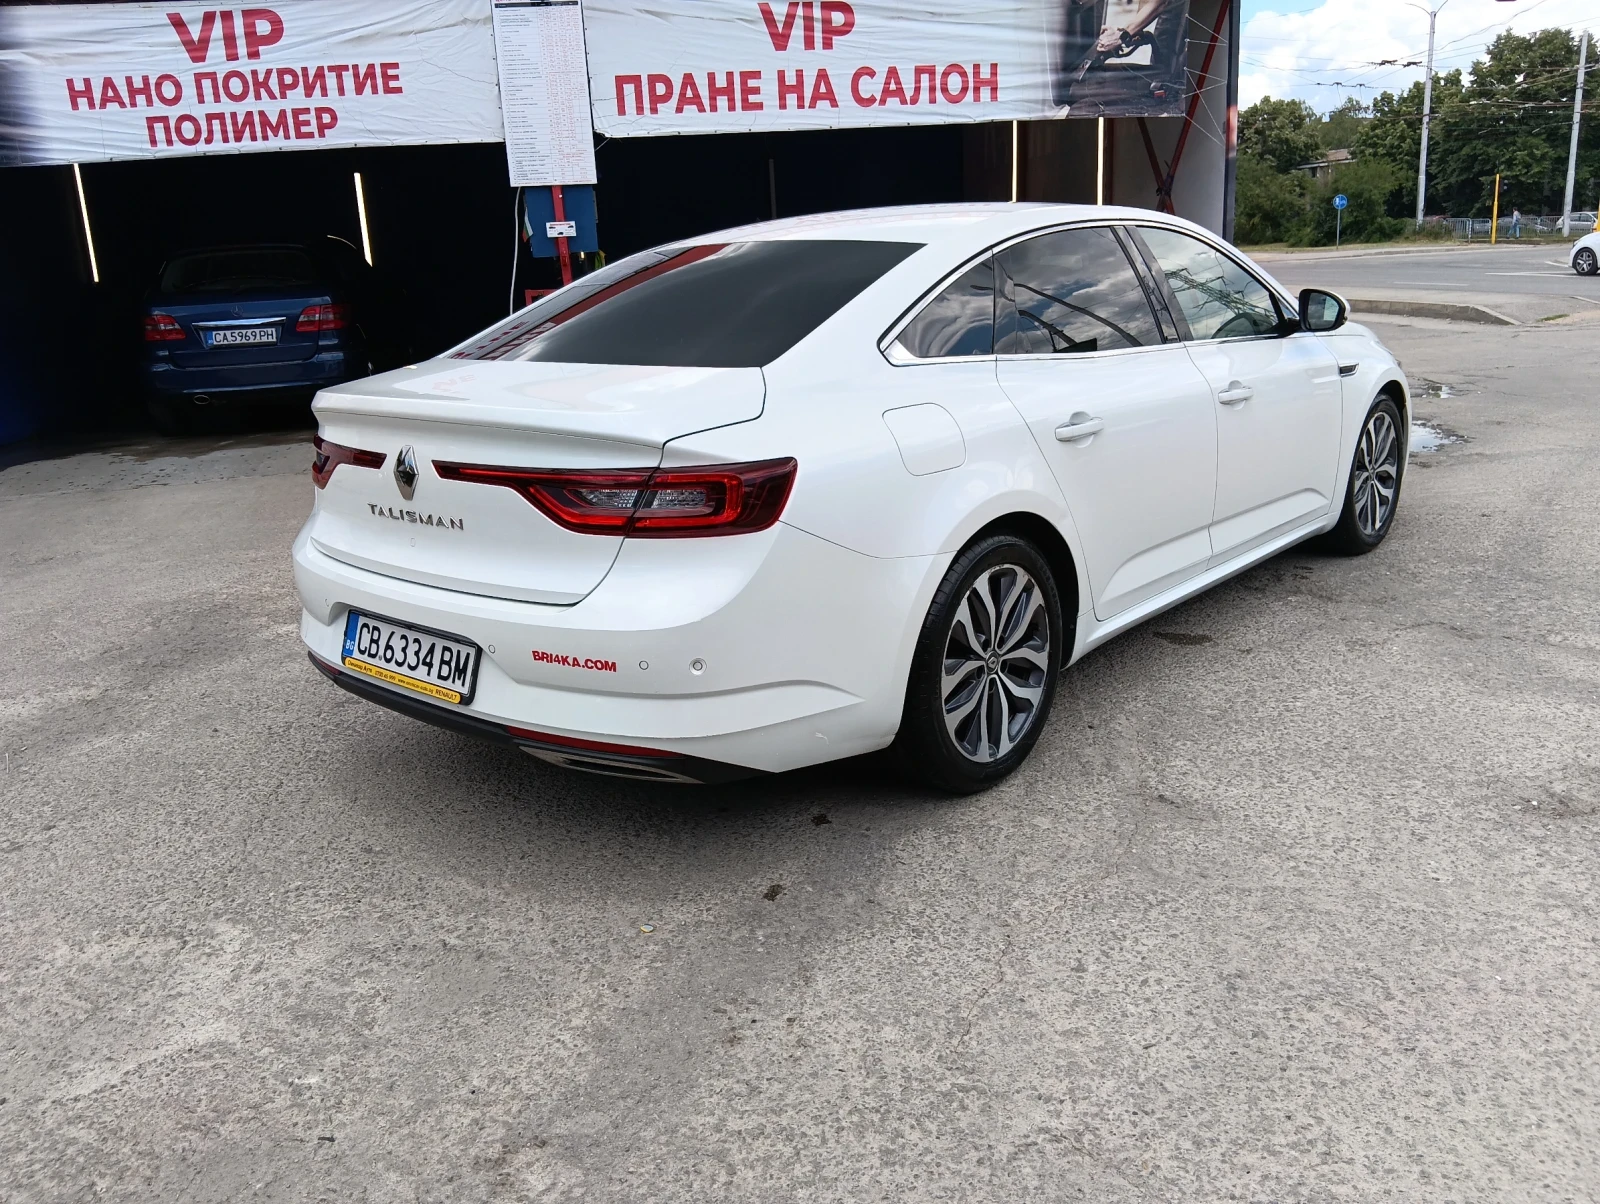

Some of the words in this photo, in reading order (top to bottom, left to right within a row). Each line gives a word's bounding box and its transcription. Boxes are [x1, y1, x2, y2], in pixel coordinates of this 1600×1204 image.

[168, 8, 284, 62] VIP
[758, 1, 856, 51] VIP
[67, 74, 183, 111] НАНО
[193, 62, 404, 105] ПОКРИТИЕ
[614, 70, 764, 116] ПРАНЕ
[777, 68, 839, 110] НА
[850, 63, 999, 108] САЛОН
[146, 106, 339, 148] ПОЛИМЕР
[367, 503, 464, 531] TALISMAN
[345, 640, 355, 650] BG
[532, 650, 617, 672] BRI4KA.COM
[435, 689, 458, 701] RENAULT
